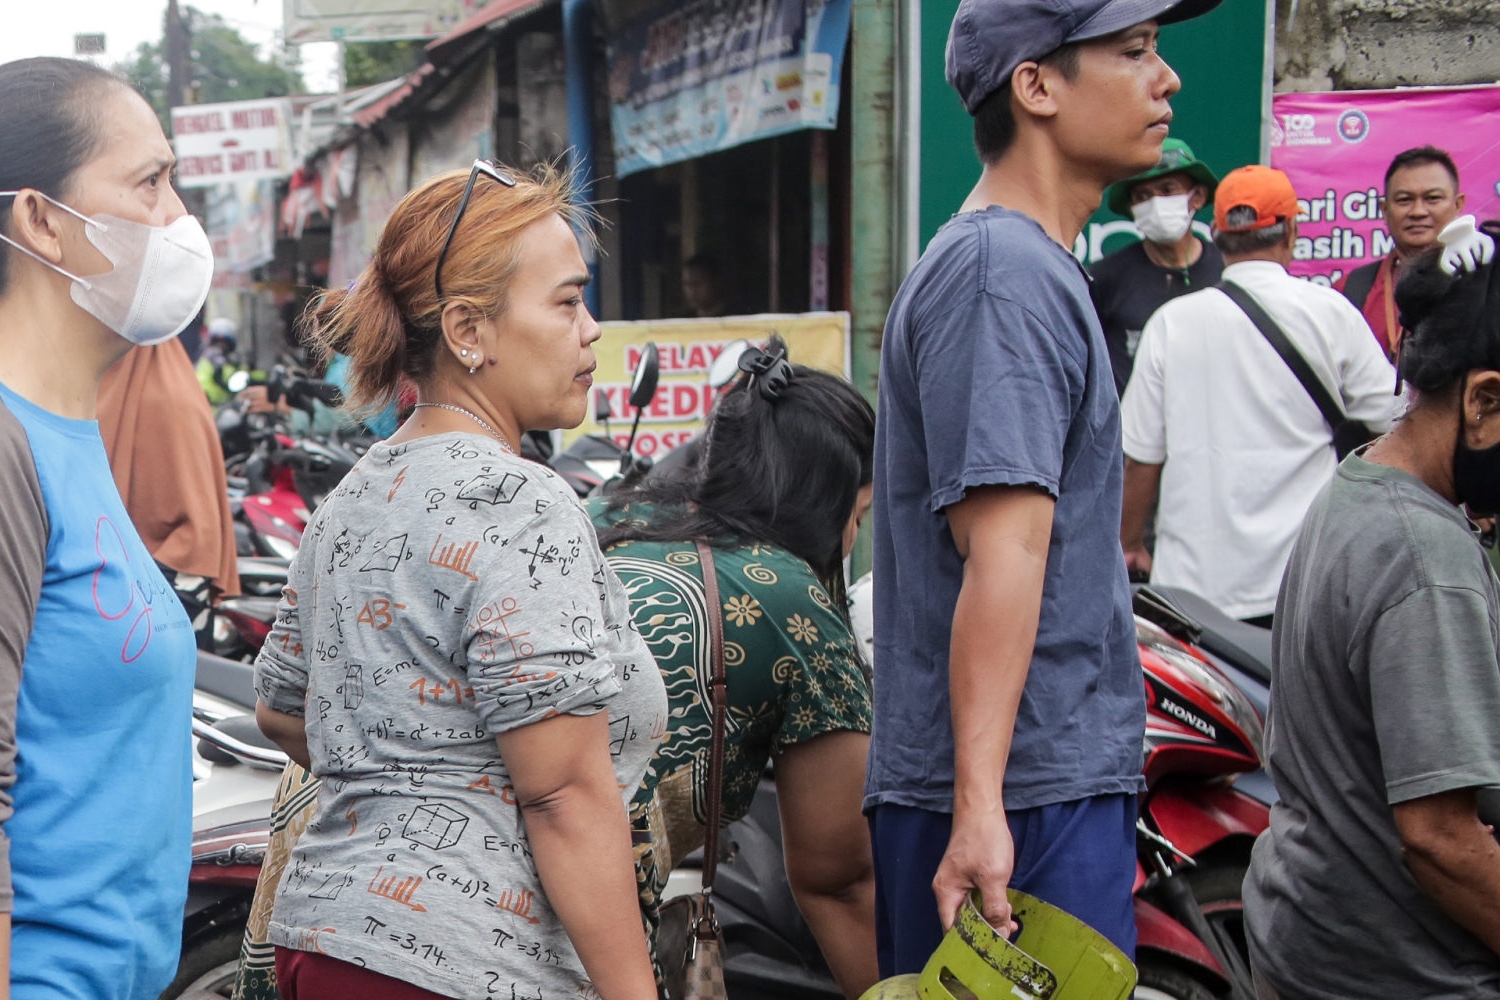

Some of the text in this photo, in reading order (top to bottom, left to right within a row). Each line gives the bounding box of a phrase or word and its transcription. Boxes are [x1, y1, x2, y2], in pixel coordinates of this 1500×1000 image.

[1295, 187, 1337, 222] ari
[1292, 227, 1365, 260] asih
[1160, 697, 1217, 739] HONDA
